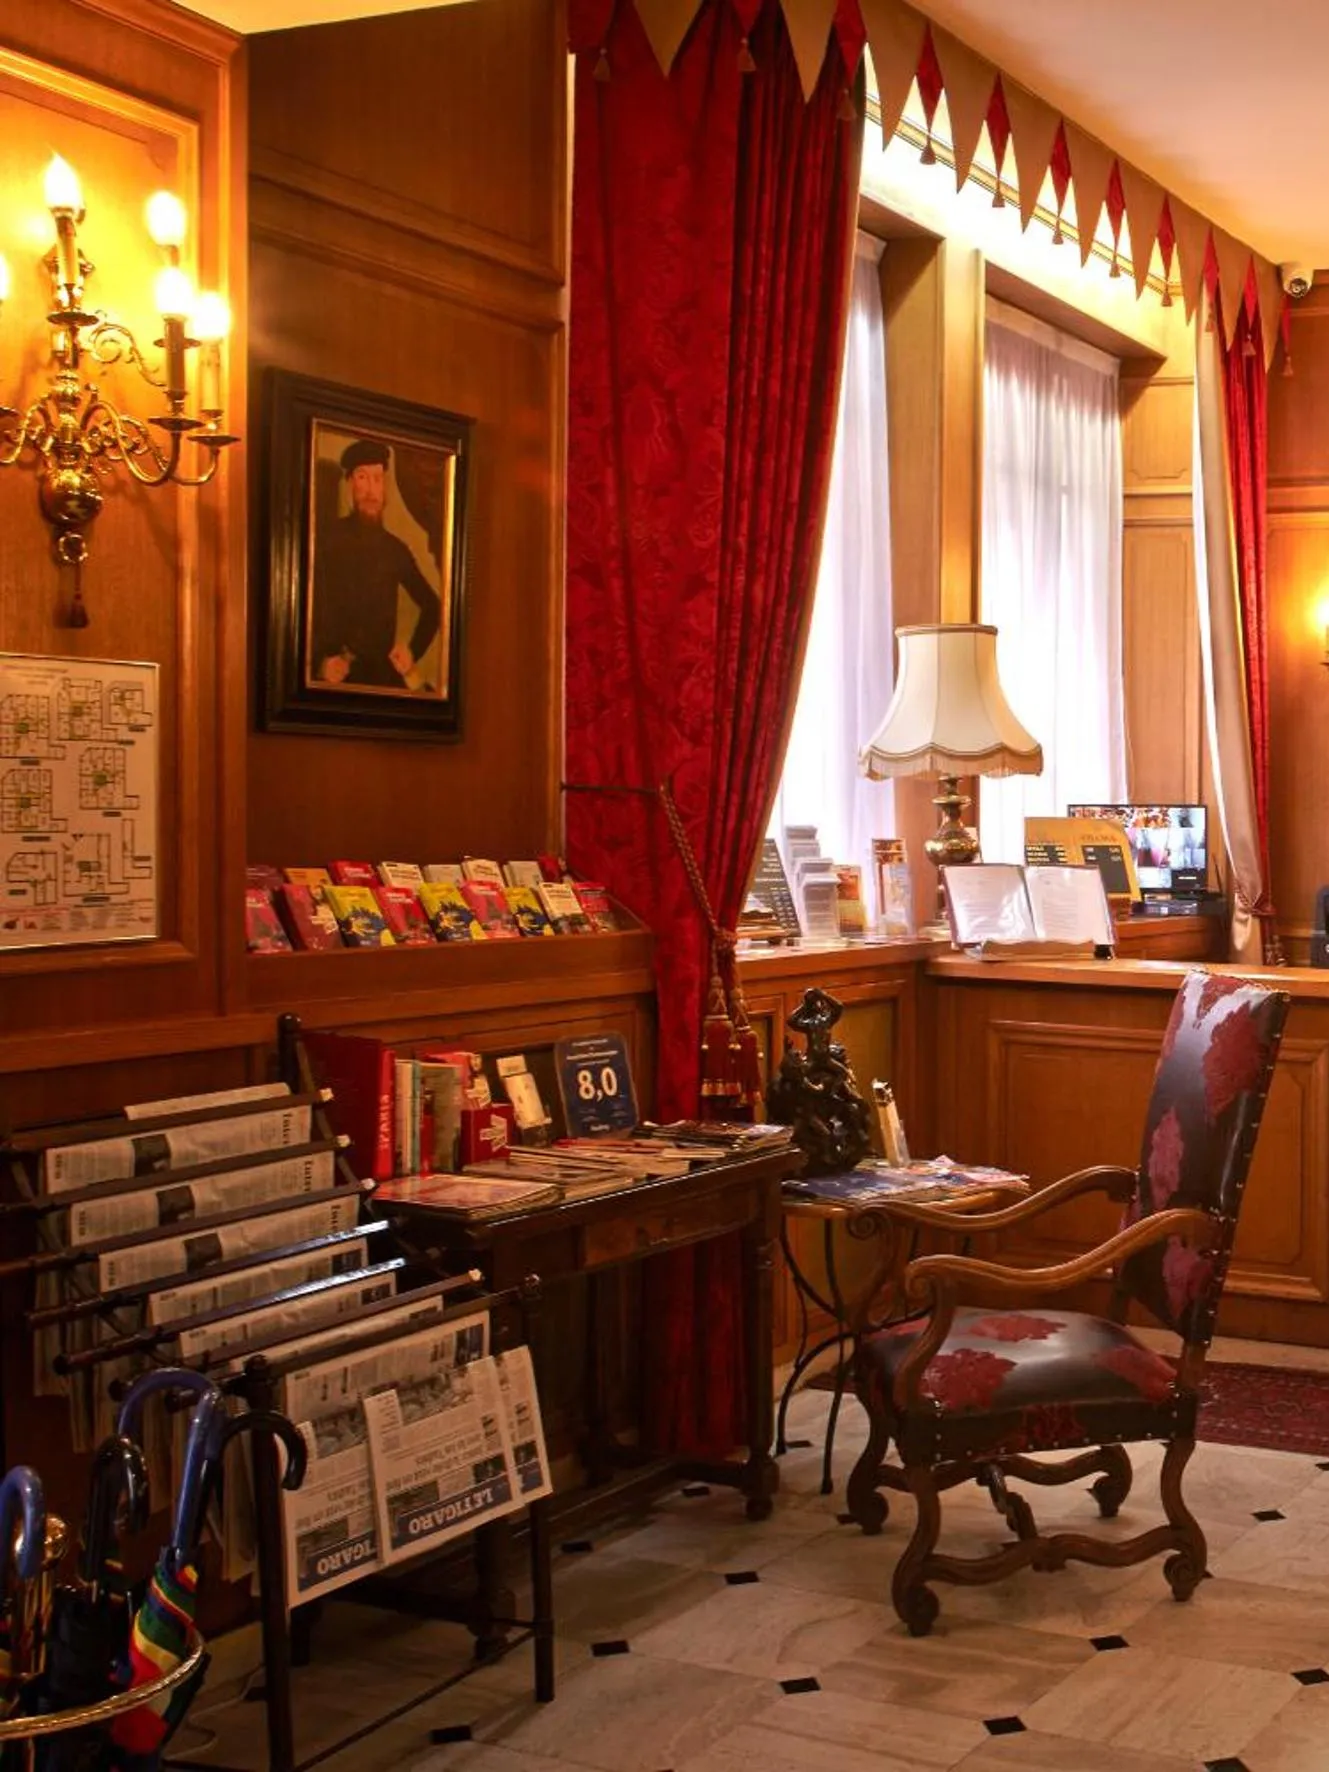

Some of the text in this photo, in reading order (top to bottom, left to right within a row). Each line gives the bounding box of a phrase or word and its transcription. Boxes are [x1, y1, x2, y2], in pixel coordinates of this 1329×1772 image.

[577, 1066, 618, 1102] 8,0
[408, 1487, 494, 1535] LE FIGARO
[317, 1539, 377, 1575] IGARO
